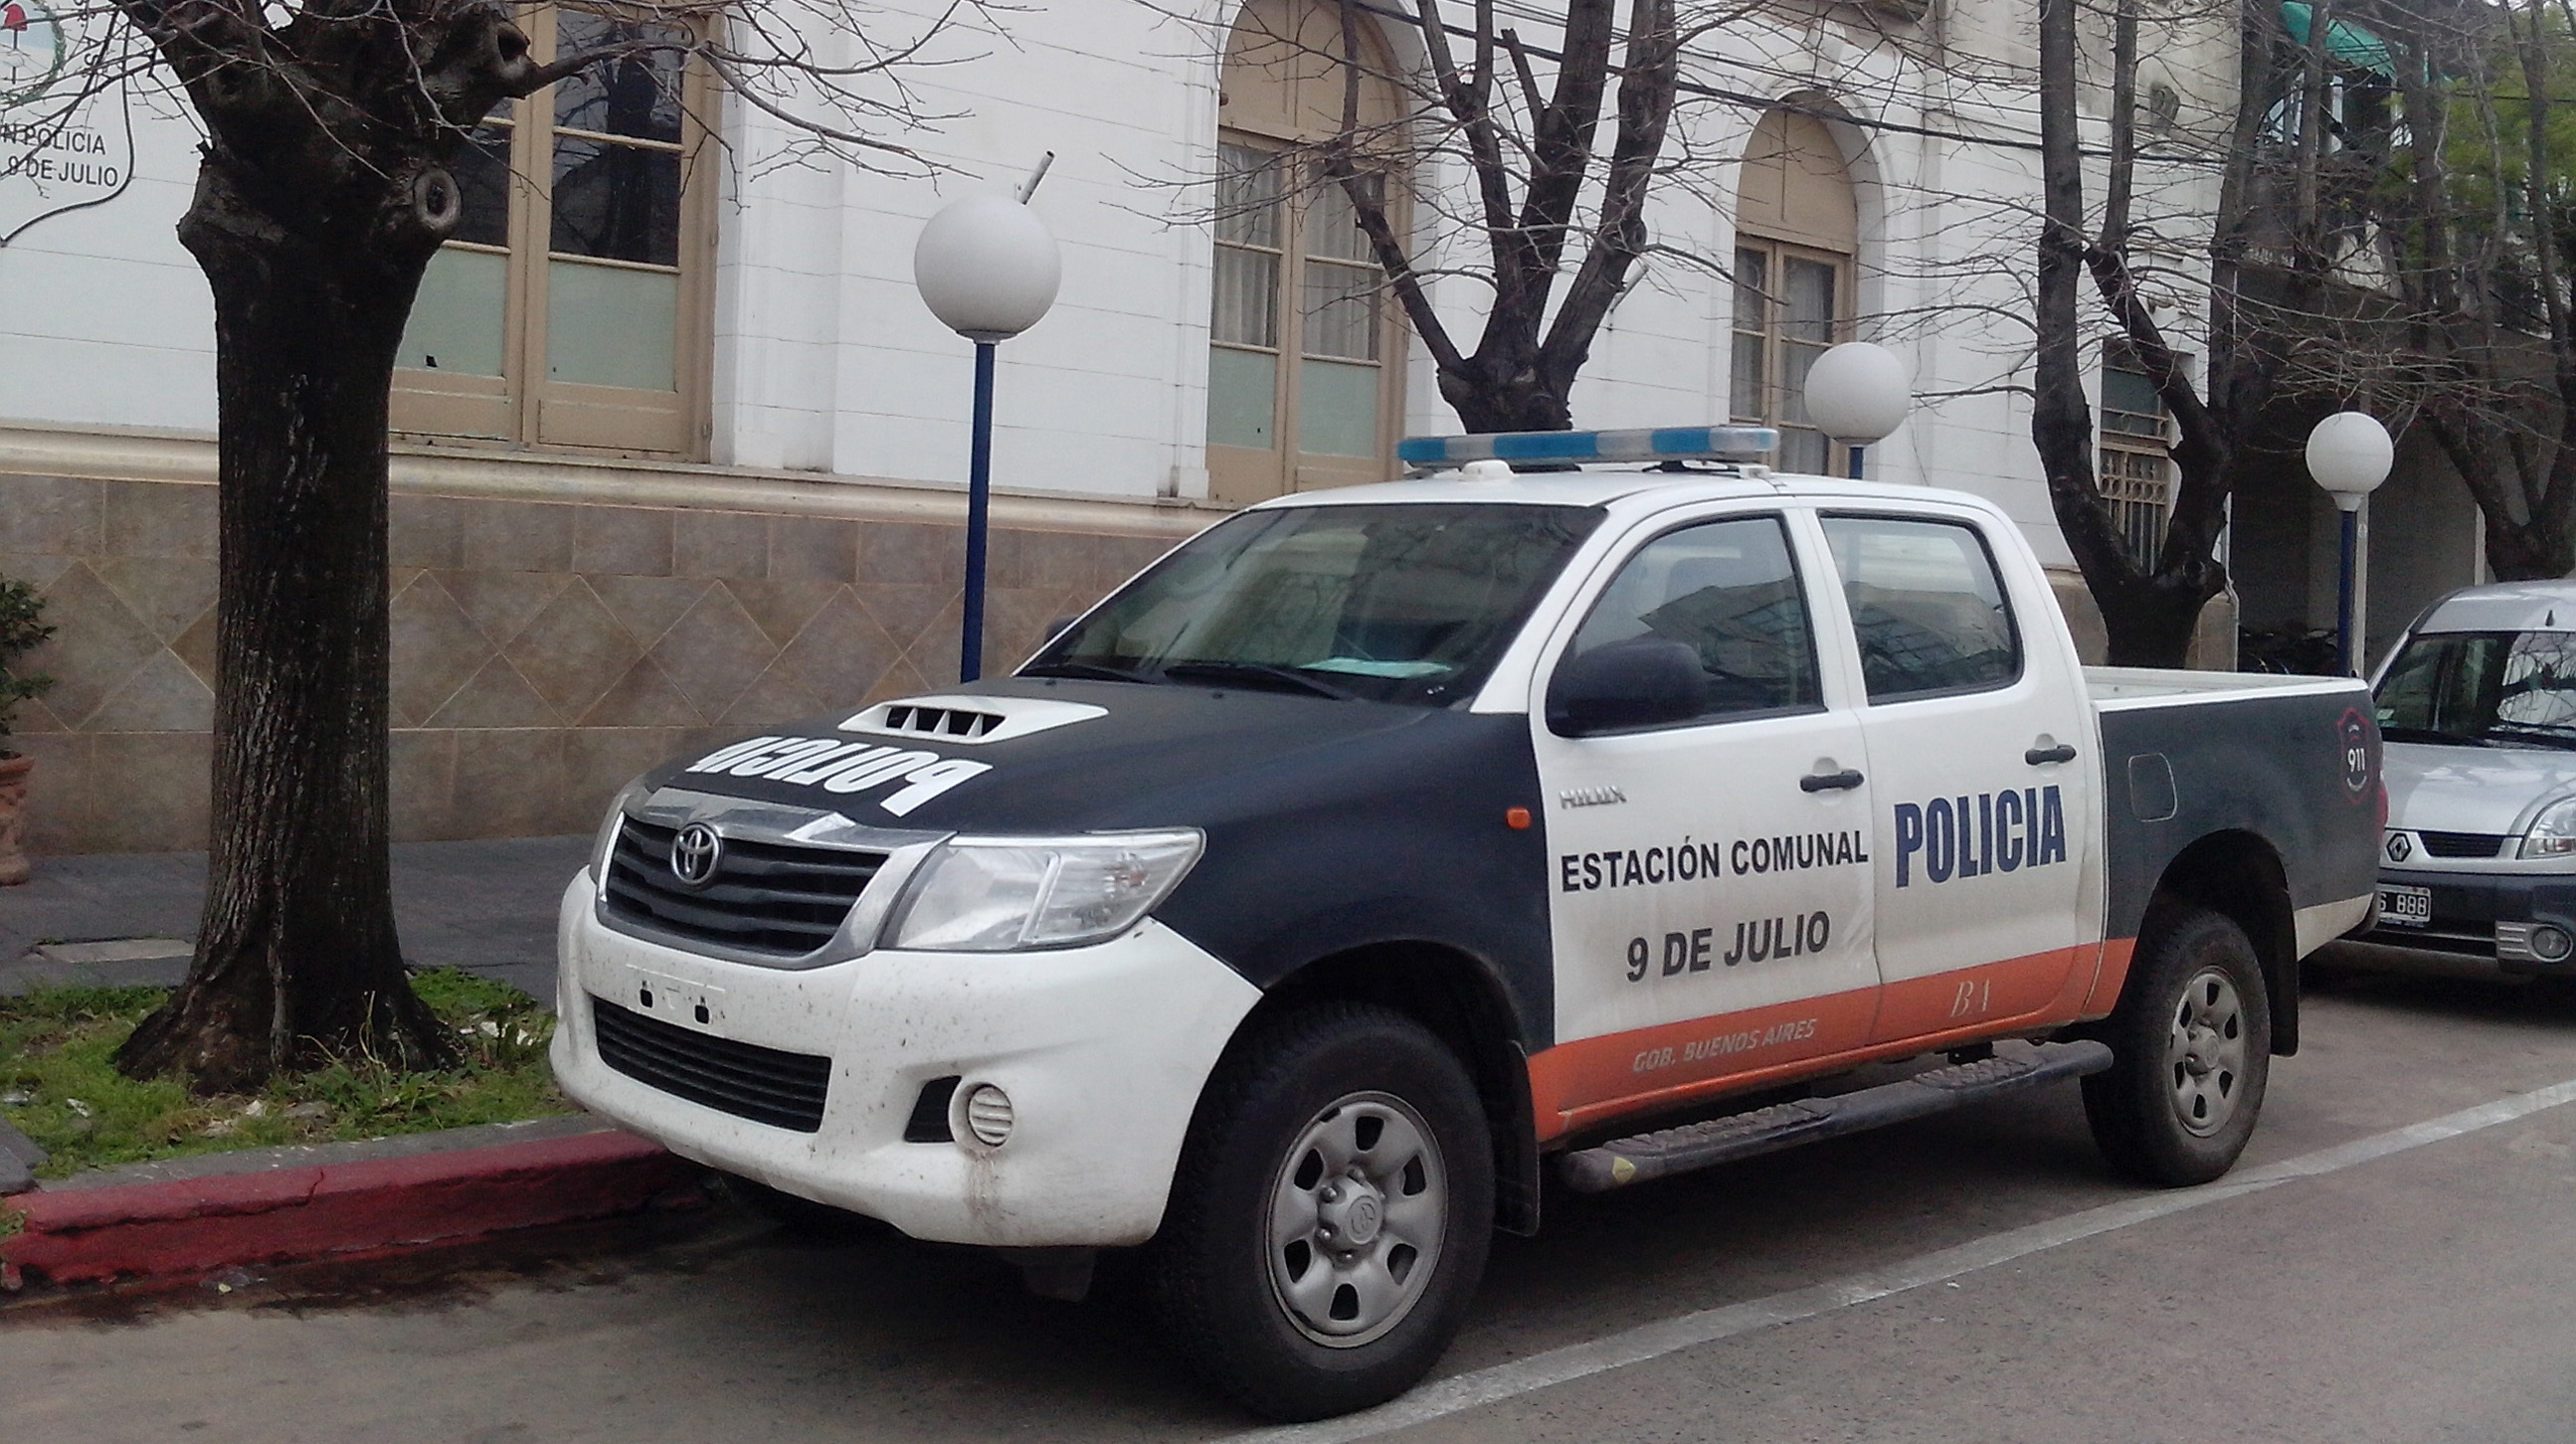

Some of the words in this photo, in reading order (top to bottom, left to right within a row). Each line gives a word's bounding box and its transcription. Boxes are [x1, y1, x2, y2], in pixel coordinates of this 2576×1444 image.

[26, 158, 53, 179] DE
[59, 161, 118, 187] JULIO
[2347, 748, 2365, 772] 911
[1559, 785, 1627, 810] HILUX
[1894, 785, 2067, 888] POLICIA
[1561, 835, 1721, 893] ESTACIÓN
[1731, 829, 1869, 876] COMUNAL
[2396, 894, 2427, 915] 888
[1626, 937, 1649, 983] 9
[1662, 928, 1713, 977] DE
[1724, 910, 1830, 967] JULIO
[1683, 1029, 1760, 1063] BUENOS
[1761, 1017, 1818, 1046] AIRES
